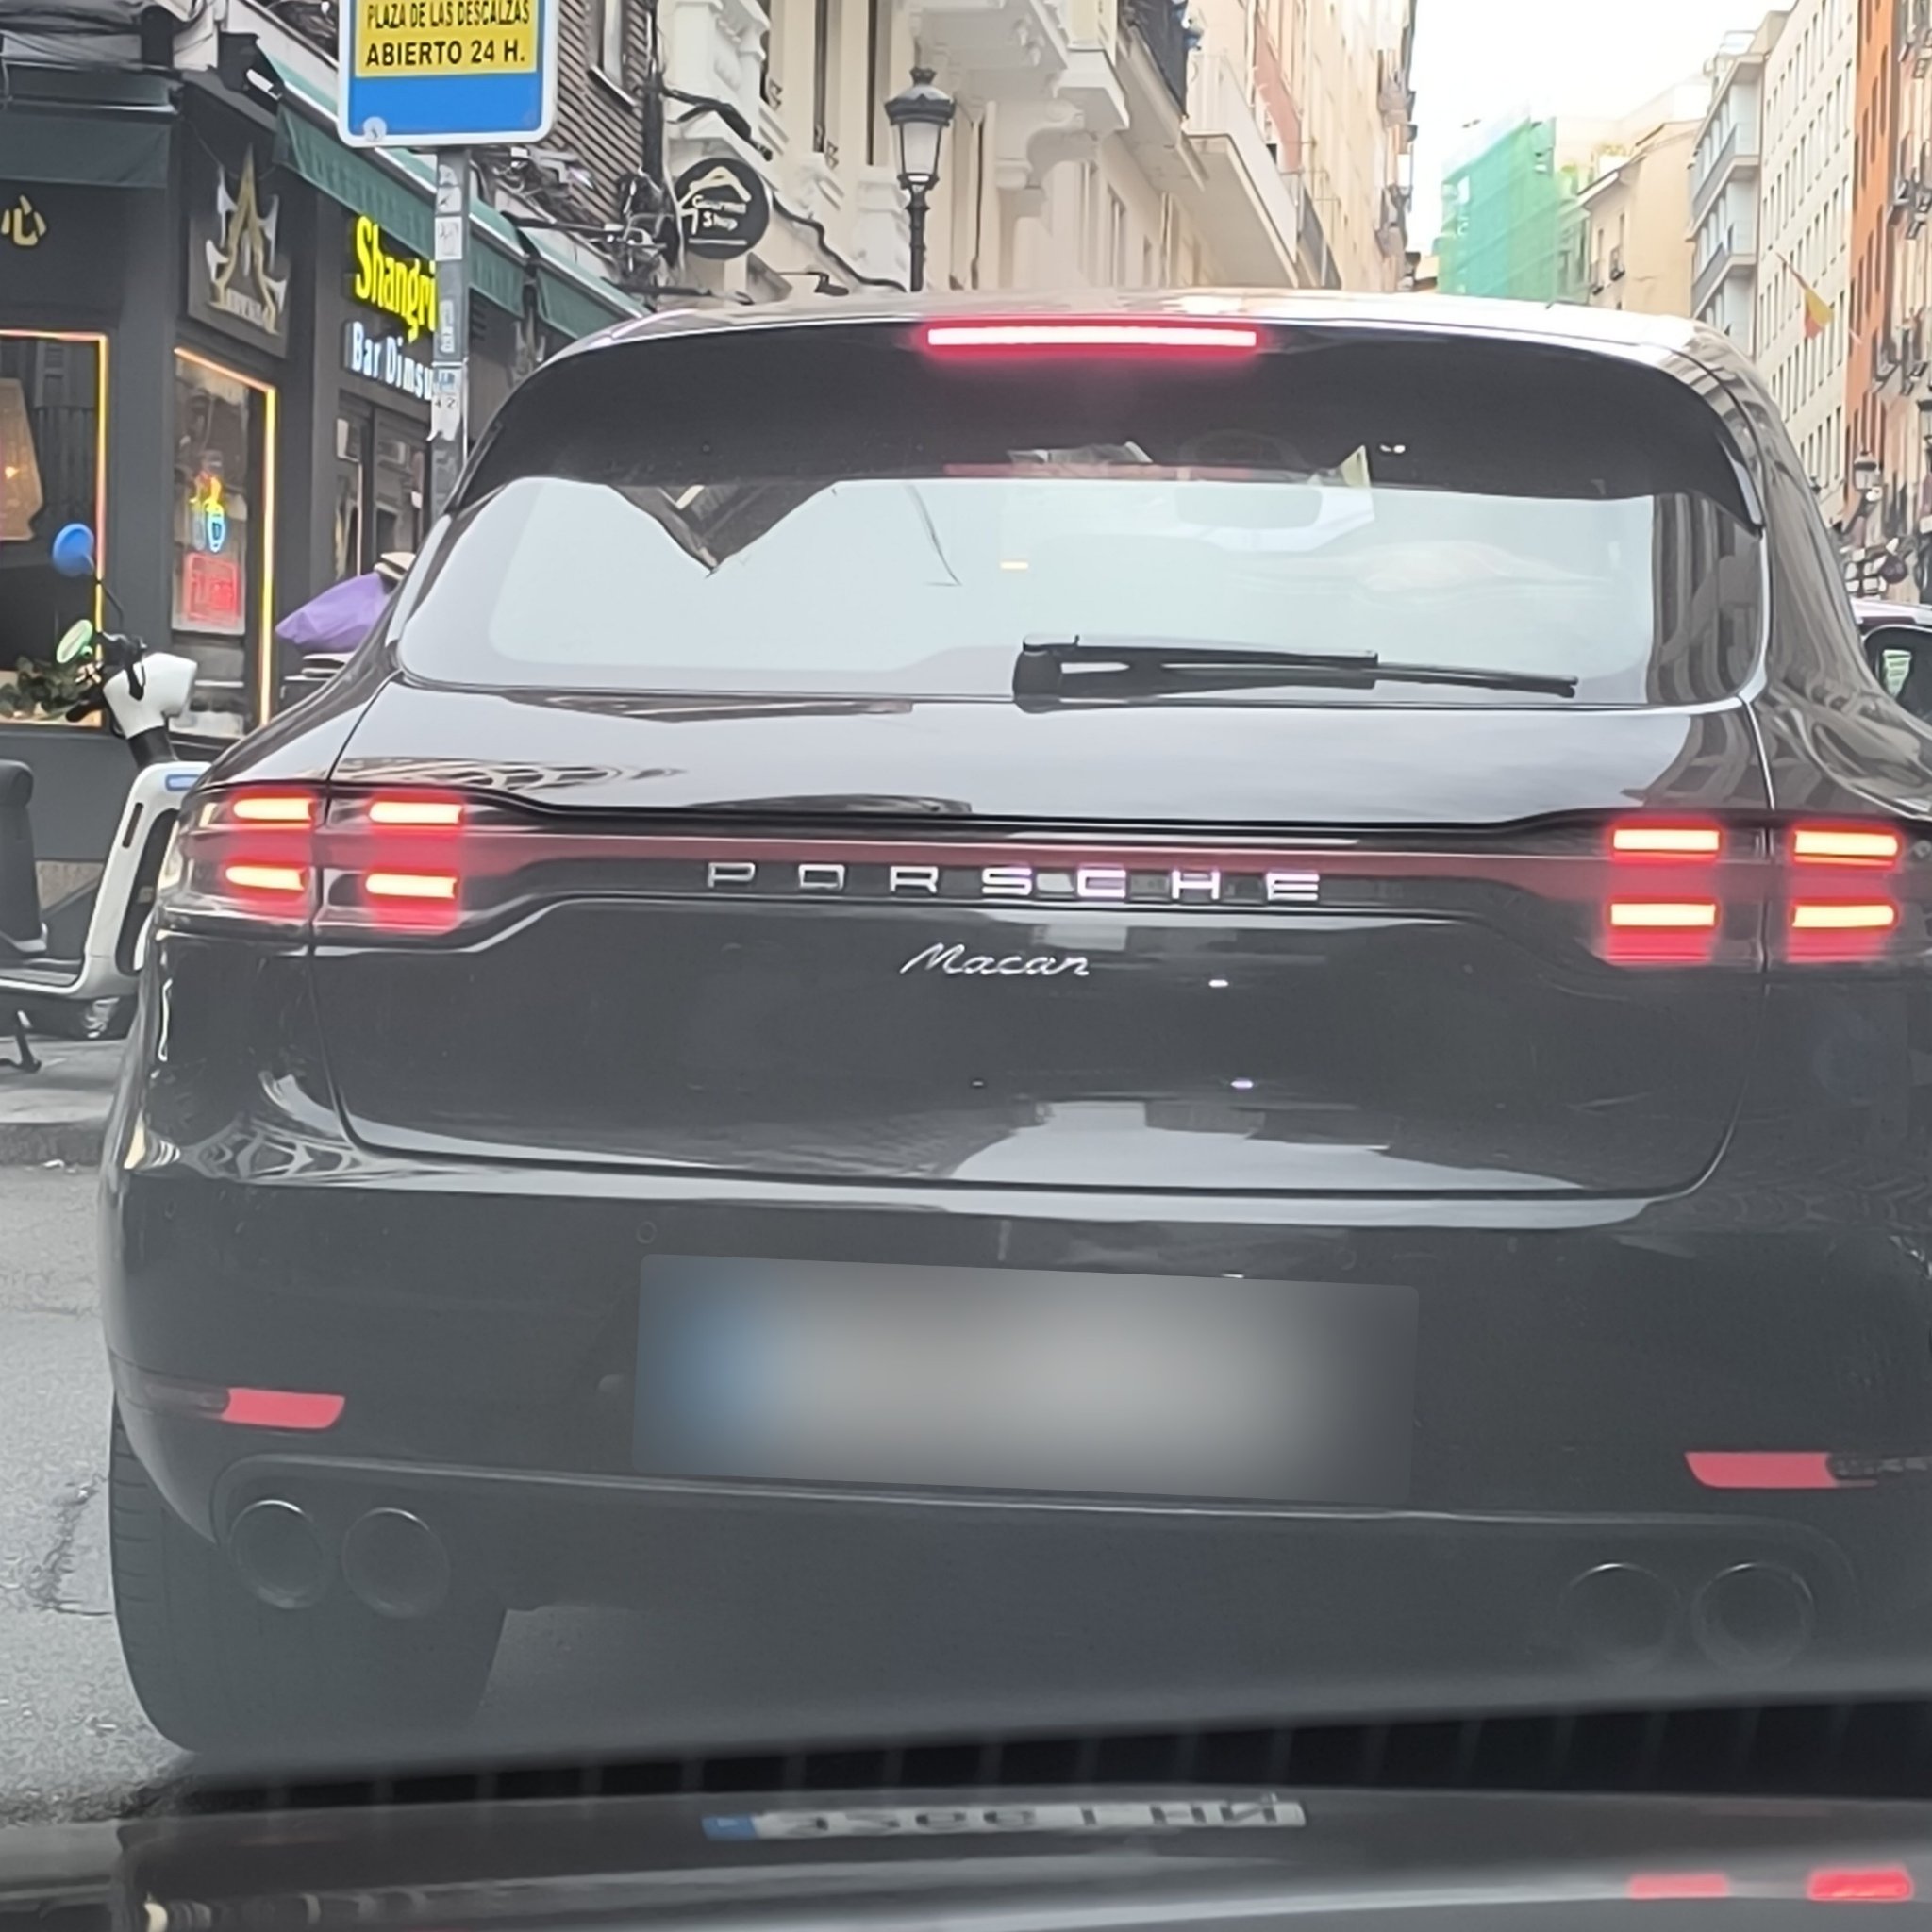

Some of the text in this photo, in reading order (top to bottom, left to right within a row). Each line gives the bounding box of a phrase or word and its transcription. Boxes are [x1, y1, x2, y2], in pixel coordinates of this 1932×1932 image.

[366, 0, 530, 29] PLAZA DE LAS DESCALZAS
[366, 39, 525, 67] ABIERTO 24 H.
[1, 195, 46, 245] 心
[356, 215, 436, 344] Shangri
[352, 321, 382, 378] Bar
[707, 862, 1320, 903] PORSCHE
[900, 943, 1091, 977] Macan
